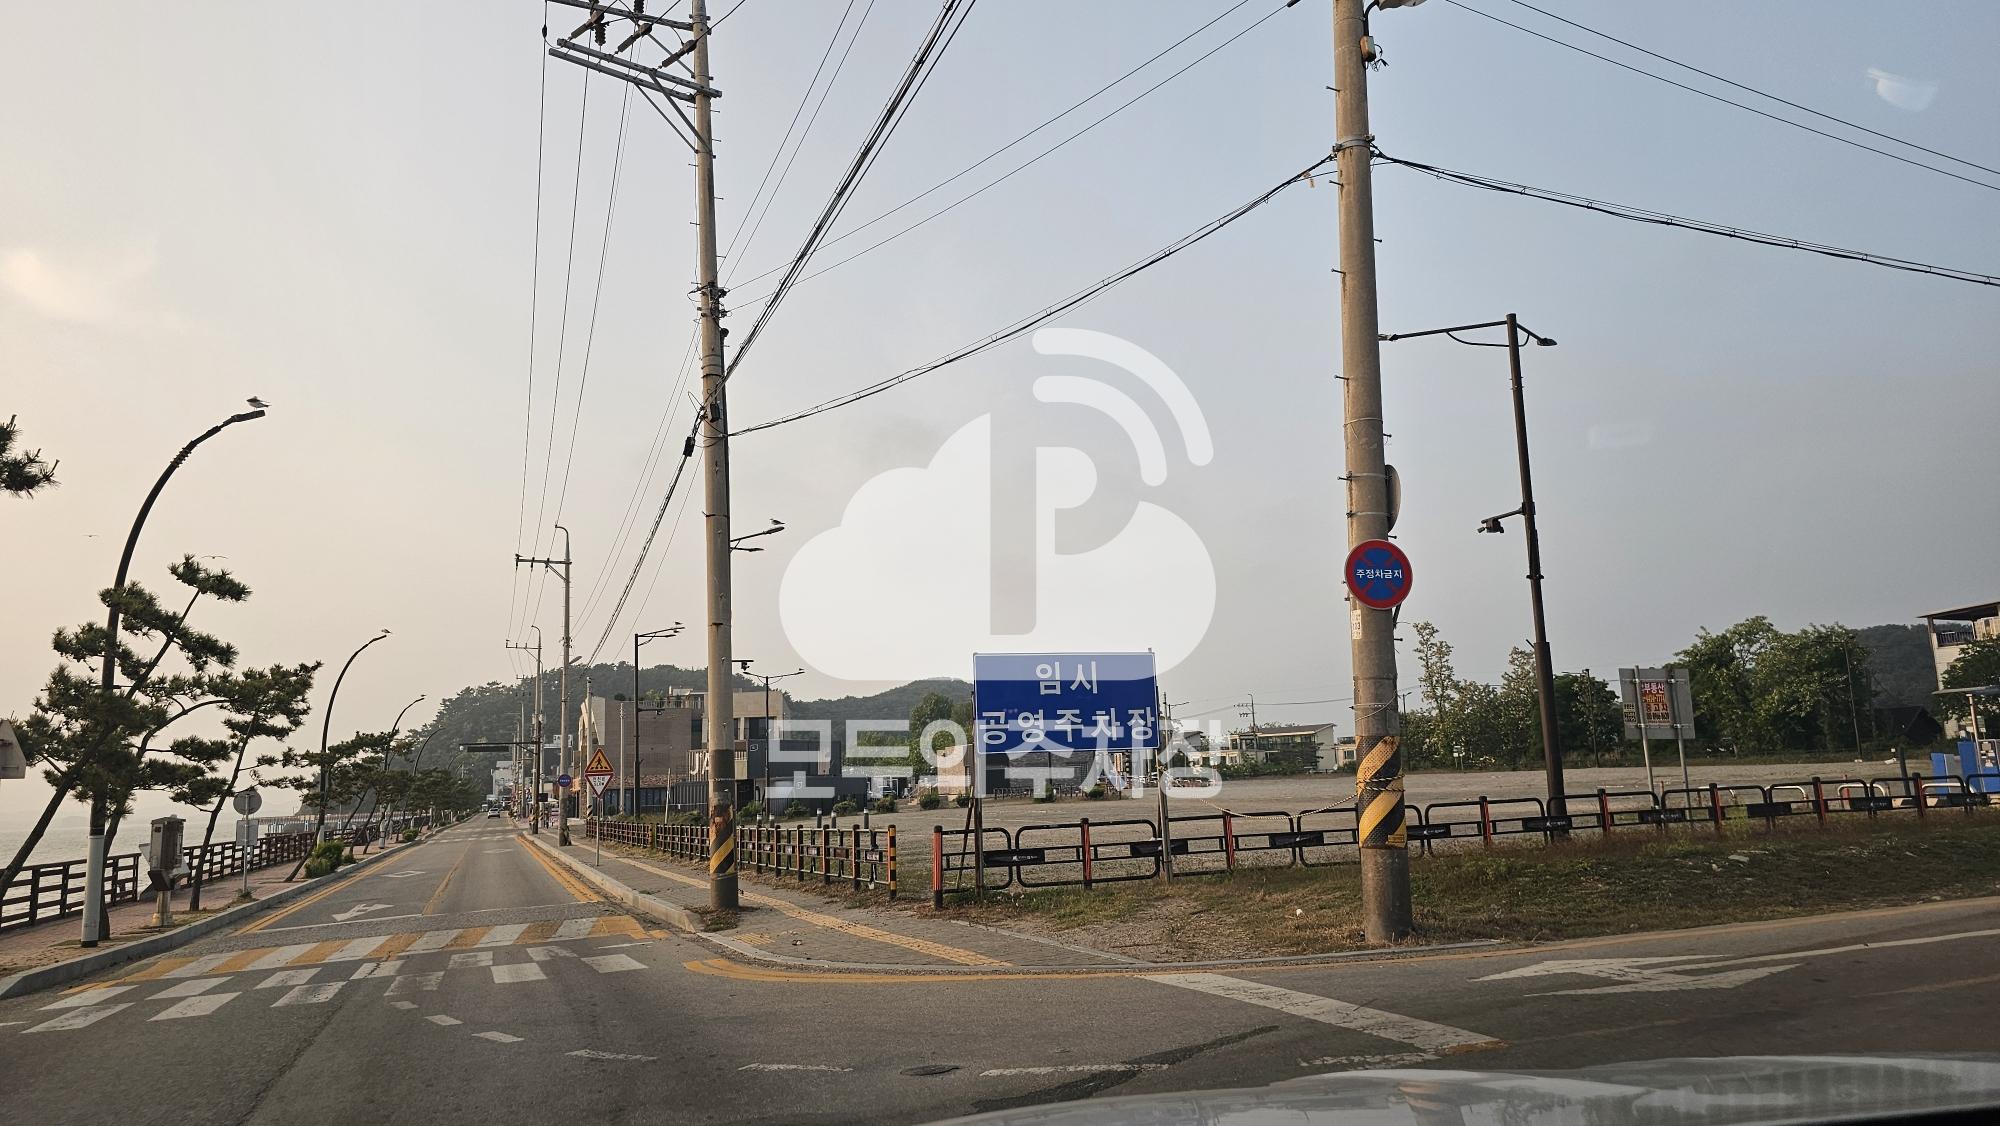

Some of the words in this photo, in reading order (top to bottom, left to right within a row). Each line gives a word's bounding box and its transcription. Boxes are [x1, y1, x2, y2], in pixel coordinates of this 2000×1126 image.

[1356, 569, 1402, 579] 주정차금지
[1035, 661, 1099, 695] 임시
[980, 706, 1155, 745] 공영주차장
